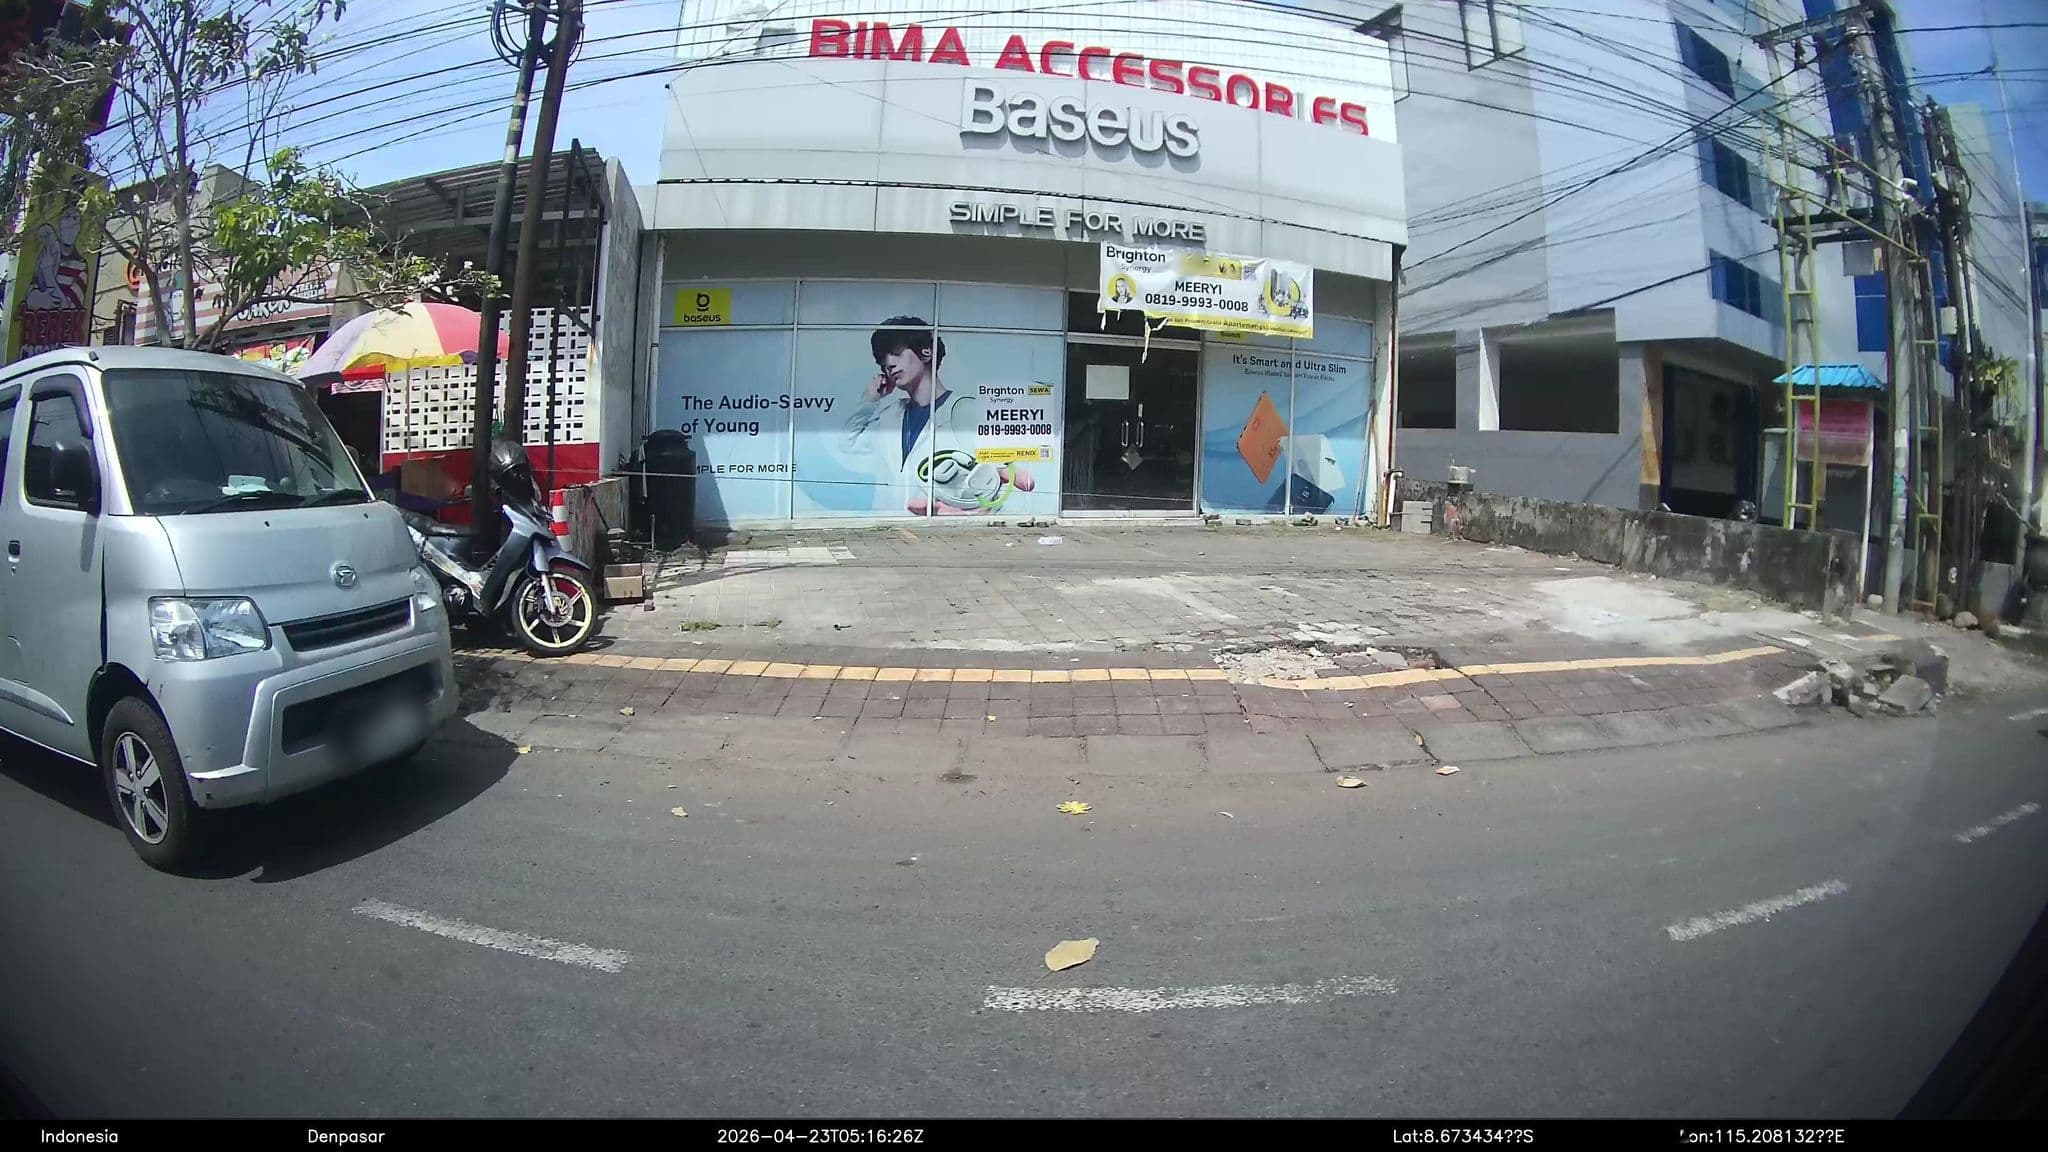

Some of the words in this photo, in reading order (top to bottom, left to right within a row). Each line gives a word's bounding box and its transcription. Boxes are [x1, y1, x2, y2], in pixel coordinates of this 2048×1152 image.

[809, 19, 970, 66] BIMA
[961, 78, 1201, 157] Baseus
[950, 201, 1055, 227] SIMPLE
[1066, 209, 1122, 233] FOR
[1133, 216, 1207, 241] MORE
[1106, 246, 1166, 263] Brighton
[1175, 280, 1222, 295] MEERYI
[1145, 293, 1249, 312] 0819-9993-0008
[683, 312, 721, 323] baseus
[1233, 354, 1247, 364] It's
[1250, 356, 1279, 368] Smart
[1280, 359, 1301, 369] and
[1304, 360, 1326, 371] Ultra
[1328, 363, 1347, 374] Slim
[681, 395, 713, 410] The
[719, 394, 835, 412] Audio-Savvy
[987, 409, 1044, 421] MEERYI
[681, 418, 698, 434] of
[704, 418, 760, 436] Young
[978, 424, 1052, 436] 0819-9993-0008
[729, 464, 753, 473] FOR
